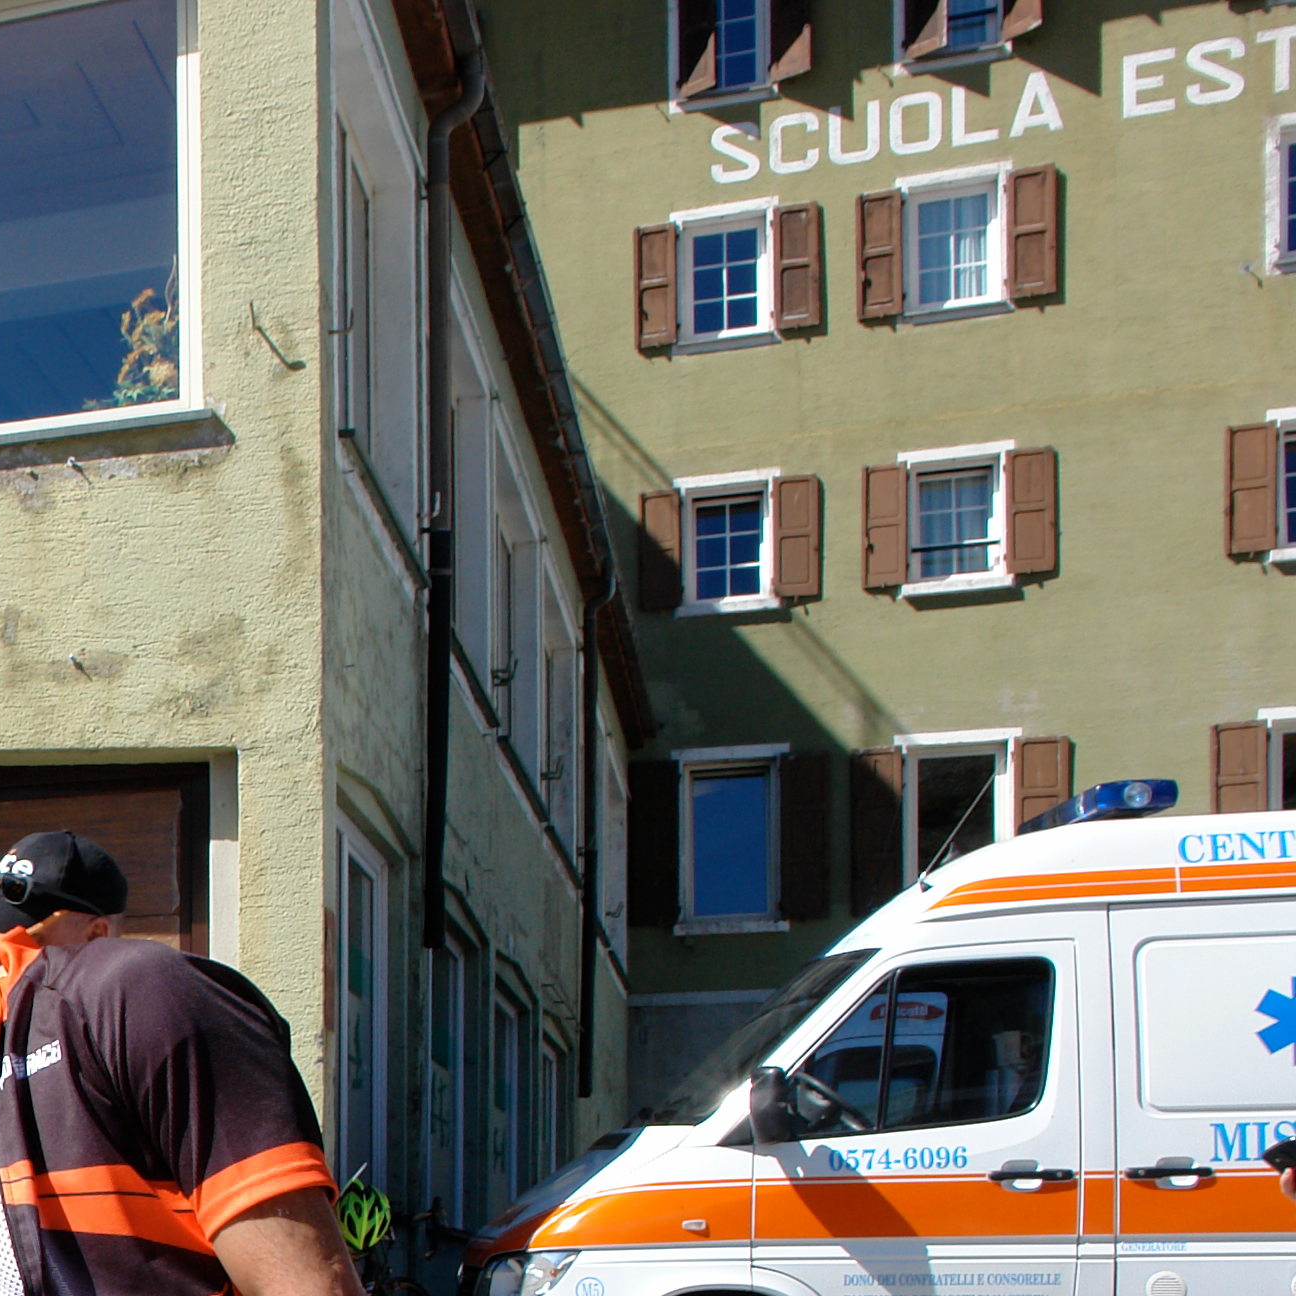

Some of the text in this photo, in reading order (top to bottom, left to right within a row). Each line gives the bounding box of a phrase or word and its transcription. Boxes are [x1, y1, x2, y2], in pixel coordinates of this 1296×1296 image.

[710, 25, 1296, 185] SCUOLA EST
[828, 1144, 968, 1173] 0574-6096
[1120, 1239, 1188, 1252] GENERATORE
[843, 1272, 1062, 1287] DONO DEI CONFRATELLI E CONSORELLE
